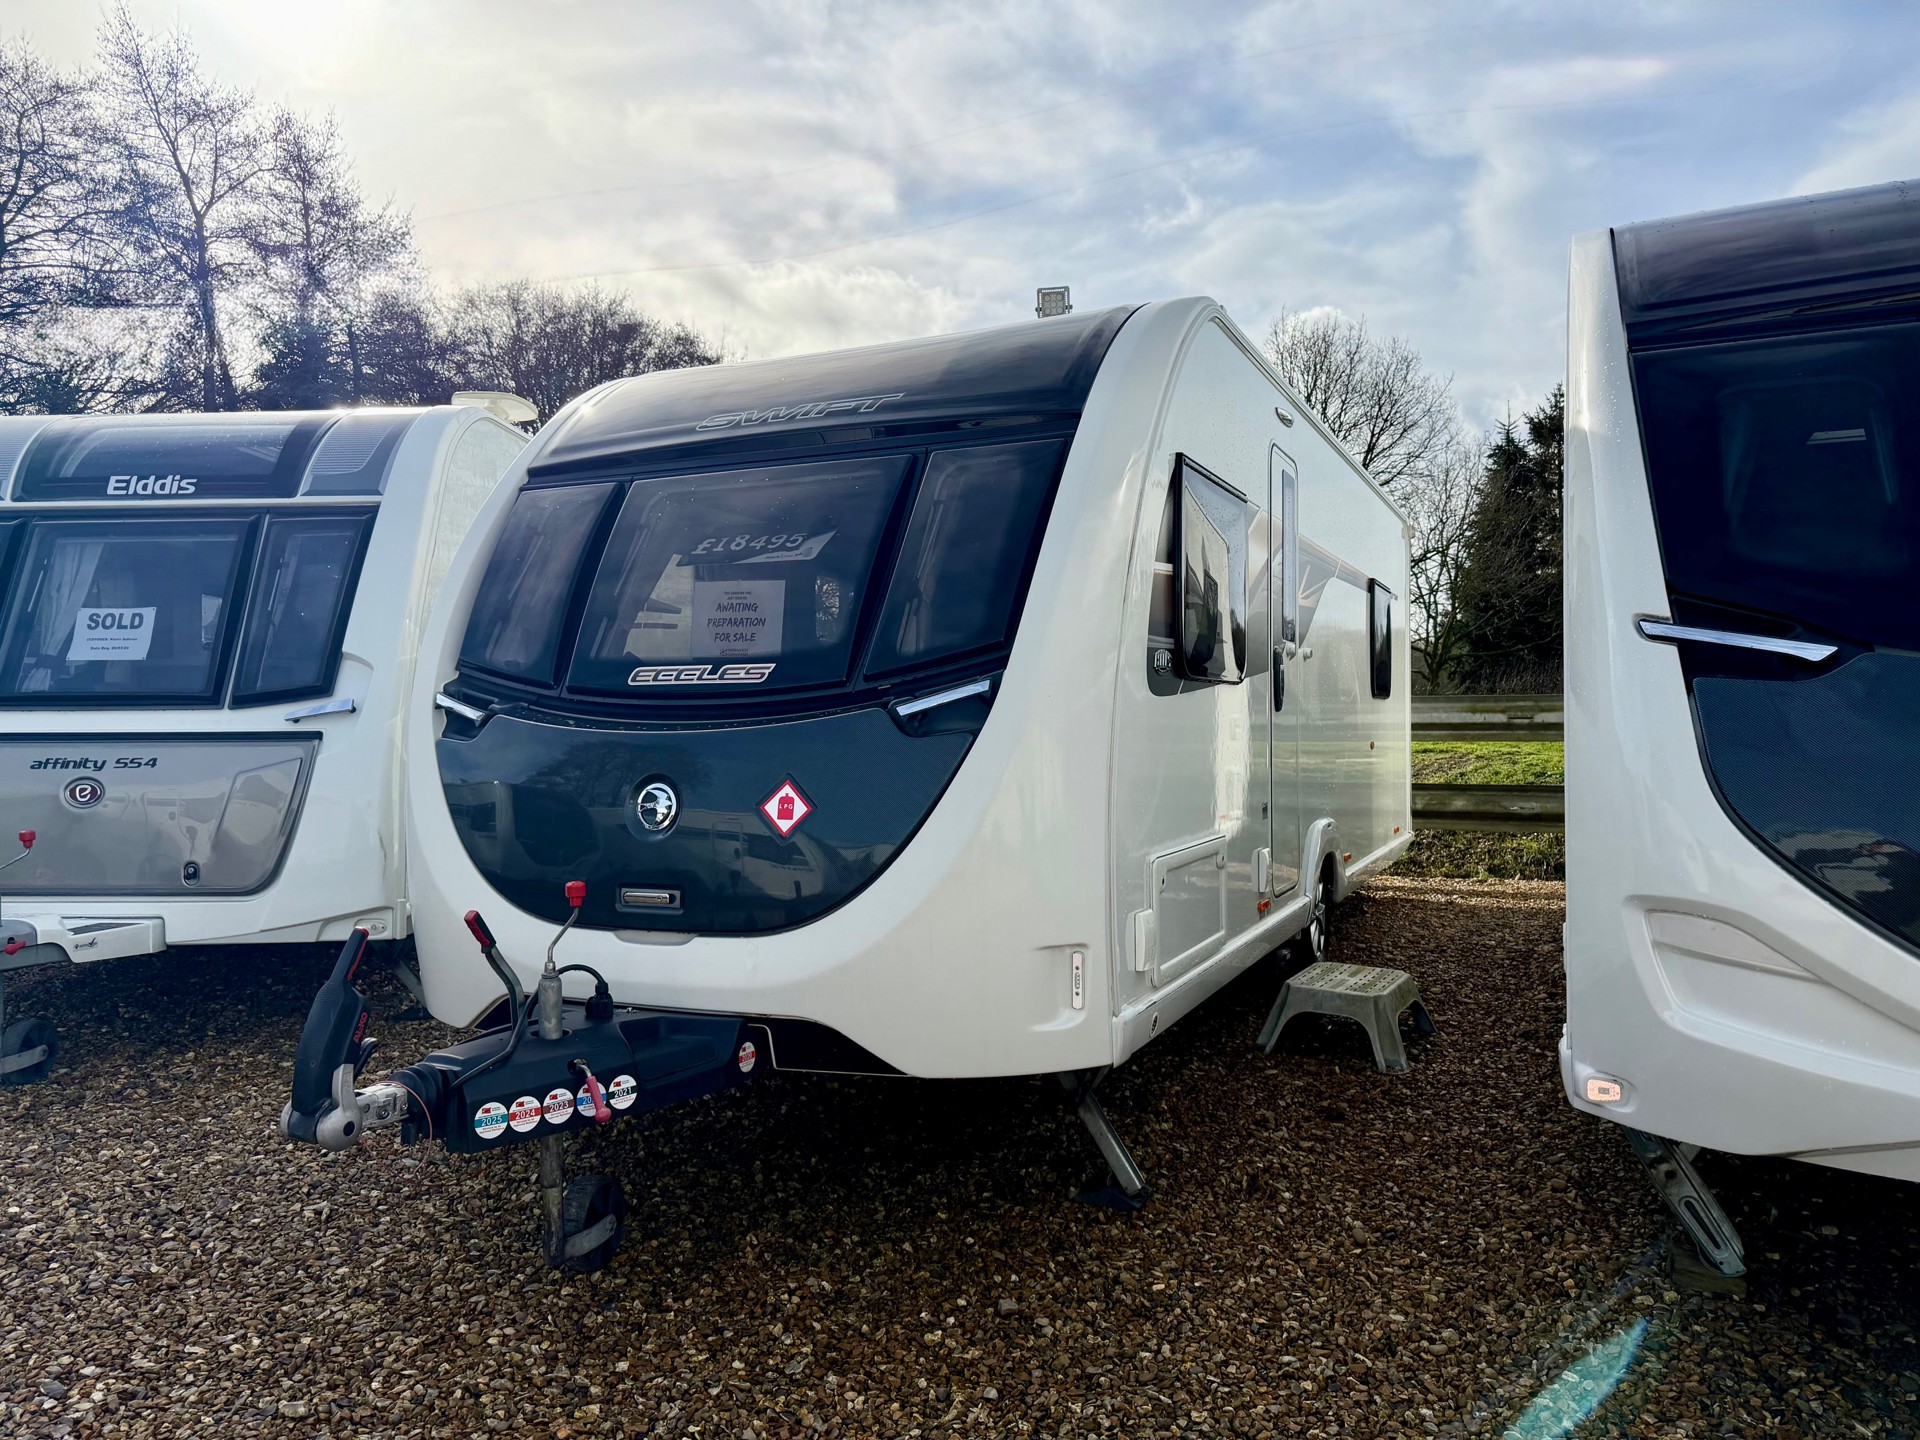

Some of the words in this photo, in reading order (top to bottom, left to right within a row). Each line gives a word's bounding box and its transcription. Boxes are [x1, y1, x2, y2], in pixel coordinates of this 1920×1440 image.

[696, 392, 906, 431] SWIFT
[106, 474, 198, 495] Elddis
[691, 532, 808, 555] £18495
[716, 602, 759, 613] AWAITING
[86, 612, 144, 630] SOLD
[707, 617, 767, 628] PREPARATION
[714, 632, 731, 643] FOR
[733, 632, 757, 643] SALE
[29, 757, 107, 772] affinity
[614, 1087, 632, 1098] 2021
[549, 1100, 569, 1112] 2023
[515, 1109, 536, 1120] 2024
[481, 1115, 503, 1127] 2025
